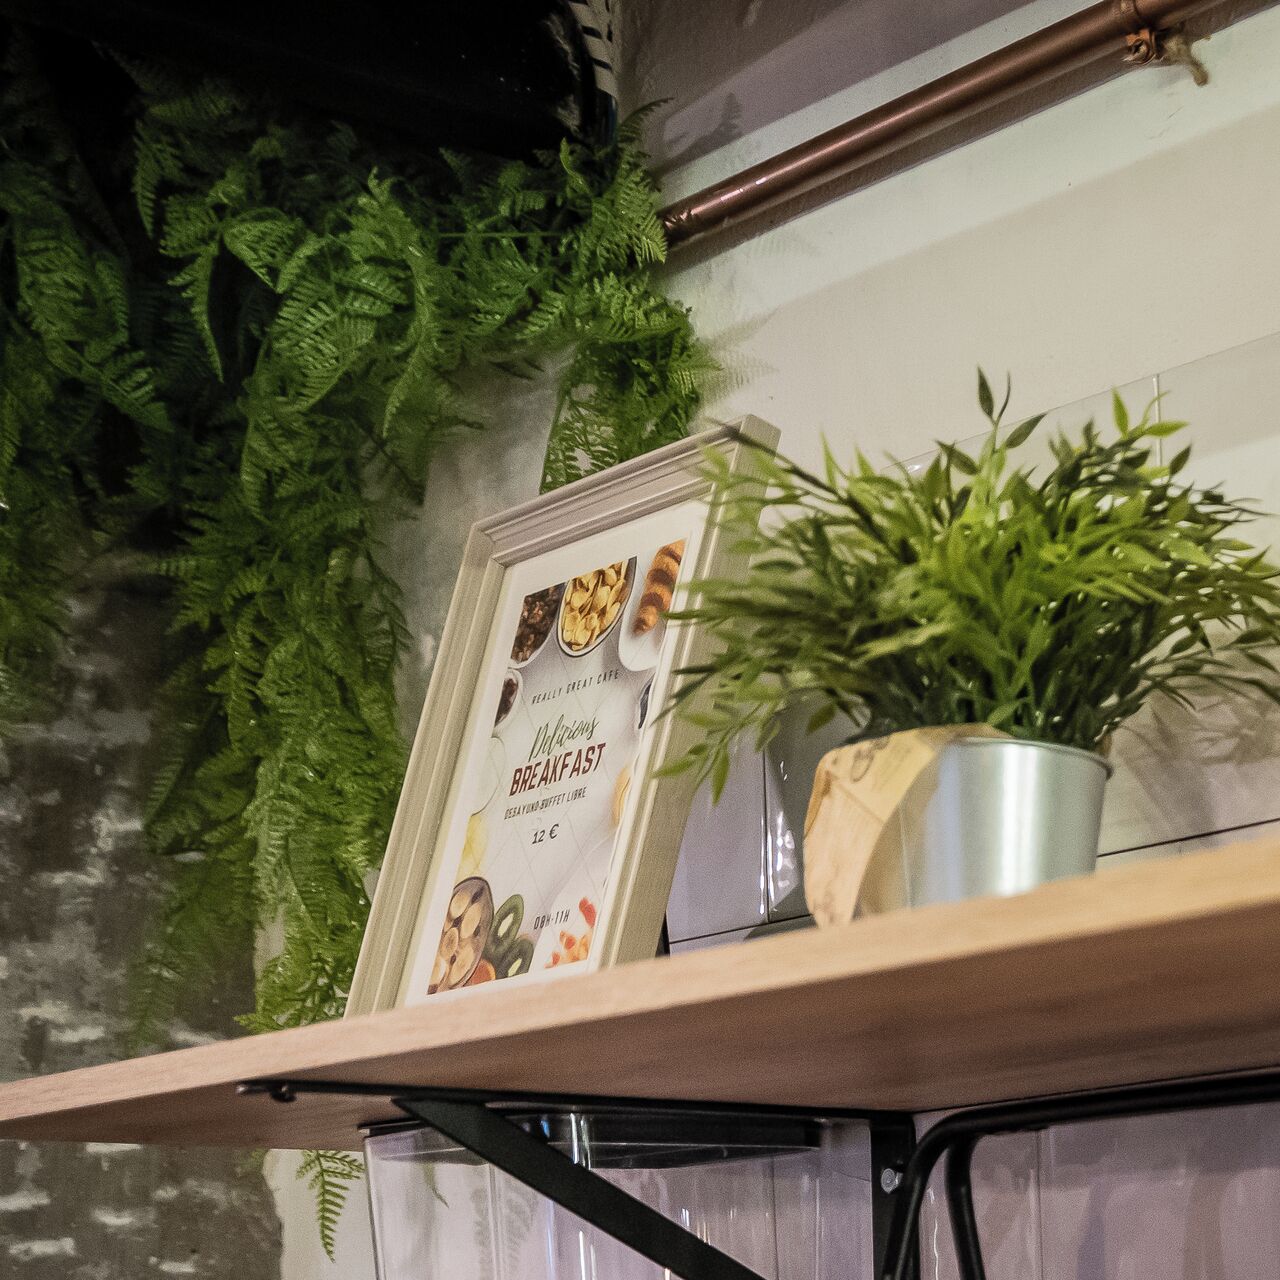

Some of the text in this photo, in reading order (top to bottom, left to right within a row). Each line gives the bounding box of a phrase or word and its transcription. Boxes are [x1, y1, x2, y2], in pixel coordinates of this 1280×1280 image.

[531, 687, 563, 705] REALLY
[566, 676, 593, 694] GREAT
[528, 714, 600, 762] Delicious
[508, 742, 606, 797] BREAKFAST
[566, 786, 588, 804] LIBRE
[532, 823, 560, 845] 12 €
